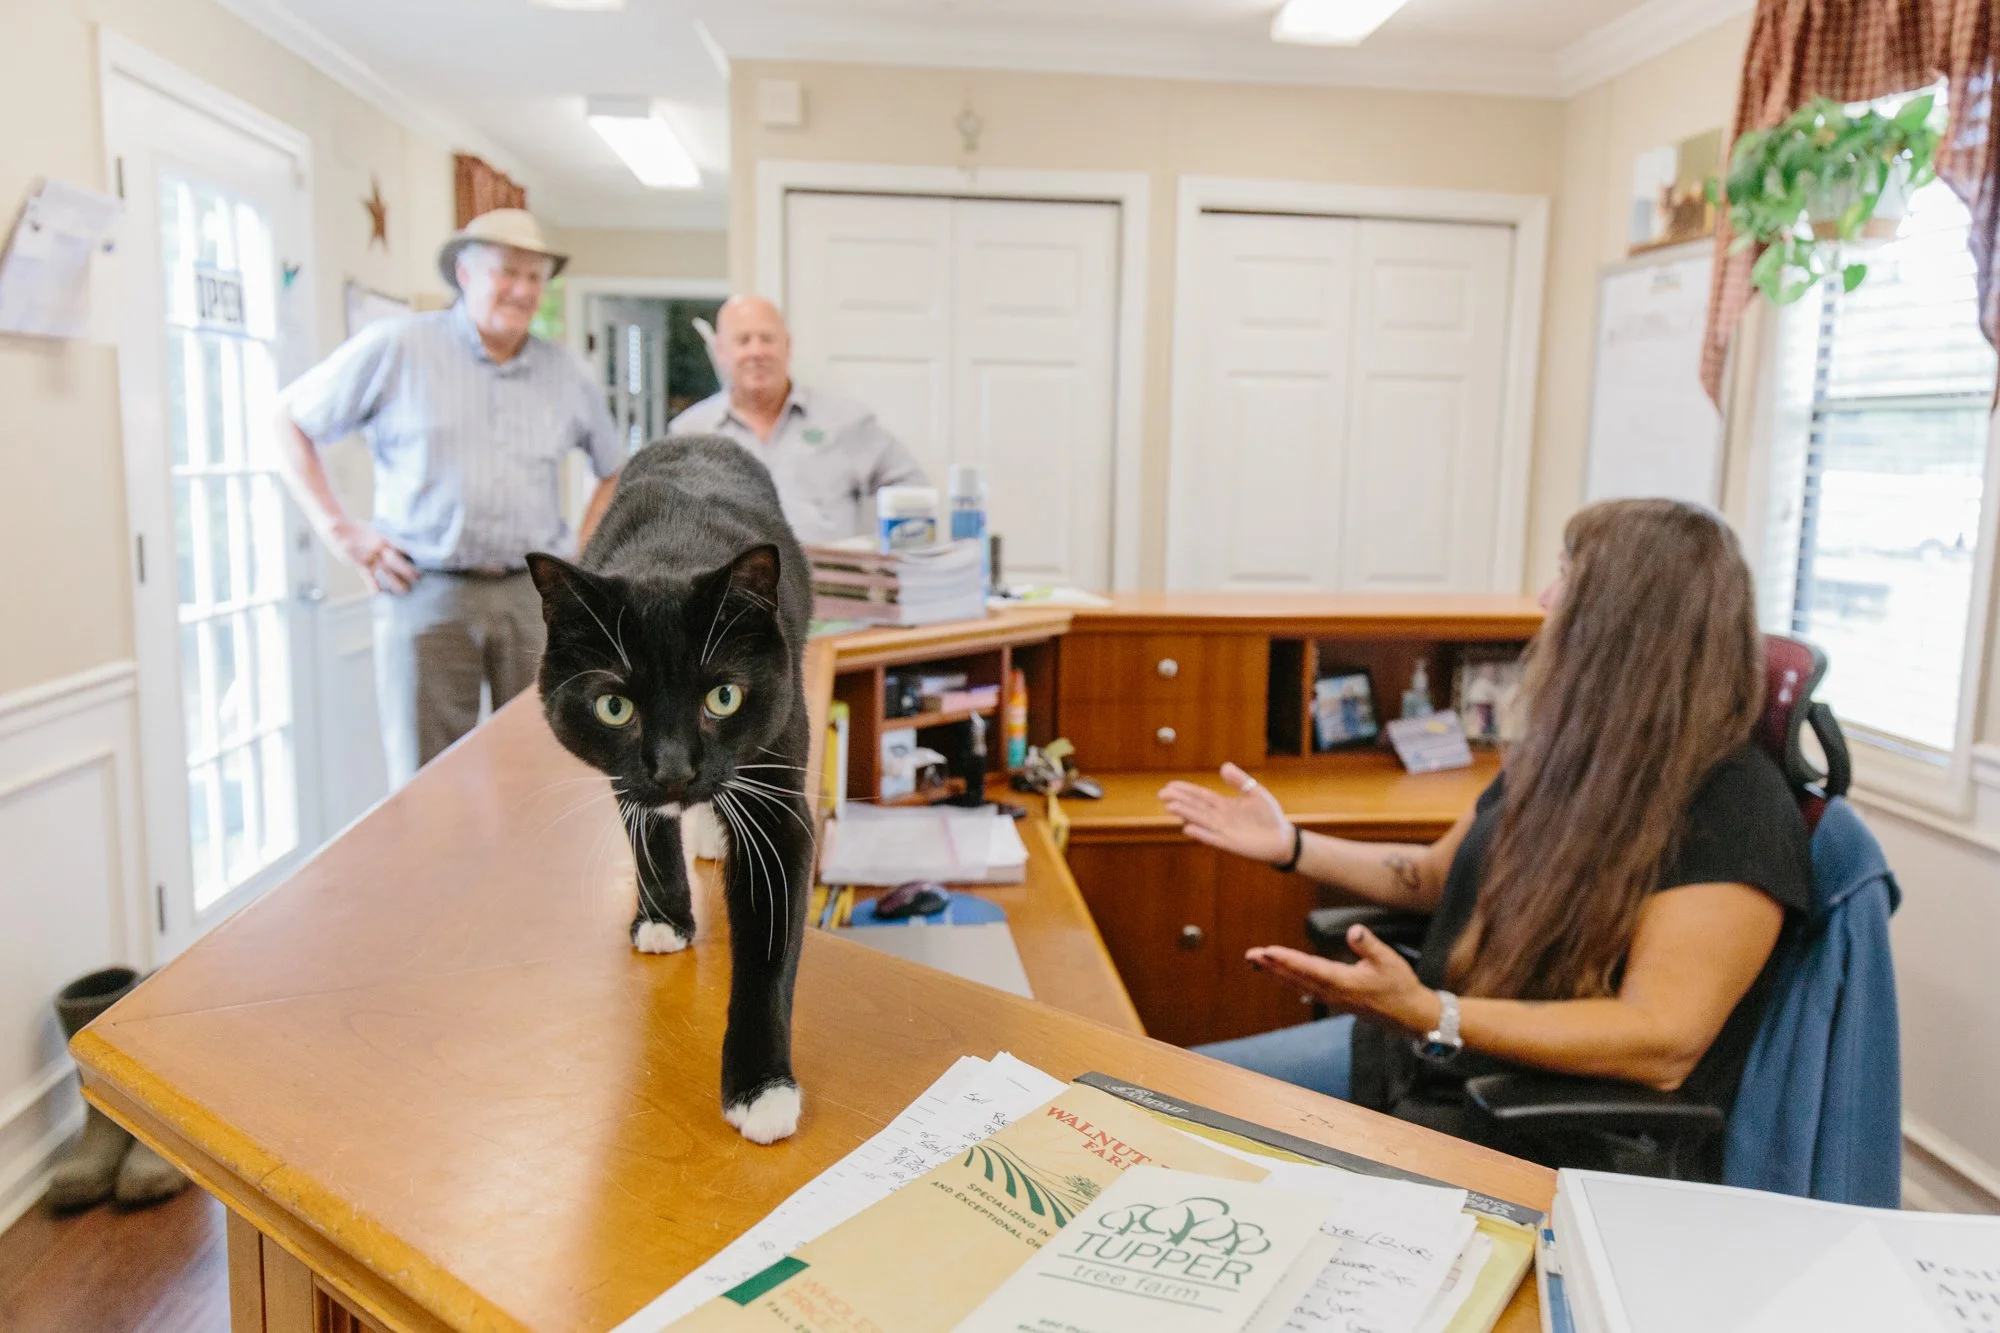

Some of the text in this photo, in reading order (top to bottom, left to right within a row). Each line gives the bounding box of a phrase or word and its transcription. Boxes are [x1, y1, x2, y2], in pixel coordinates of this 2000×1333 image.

[1047, 1106, 1152, 1165] WALNUT
[931, 1181, 954, 1194] AND
[954, 1192, 1022, 1240] EXCEPTIONAL
[967, 1183, 1051, 1238] SPECIALIZING IN
[1073, 1264, 1200, 1300] tree farm
[1075, 1231, 1253, 1285] TUPPER
